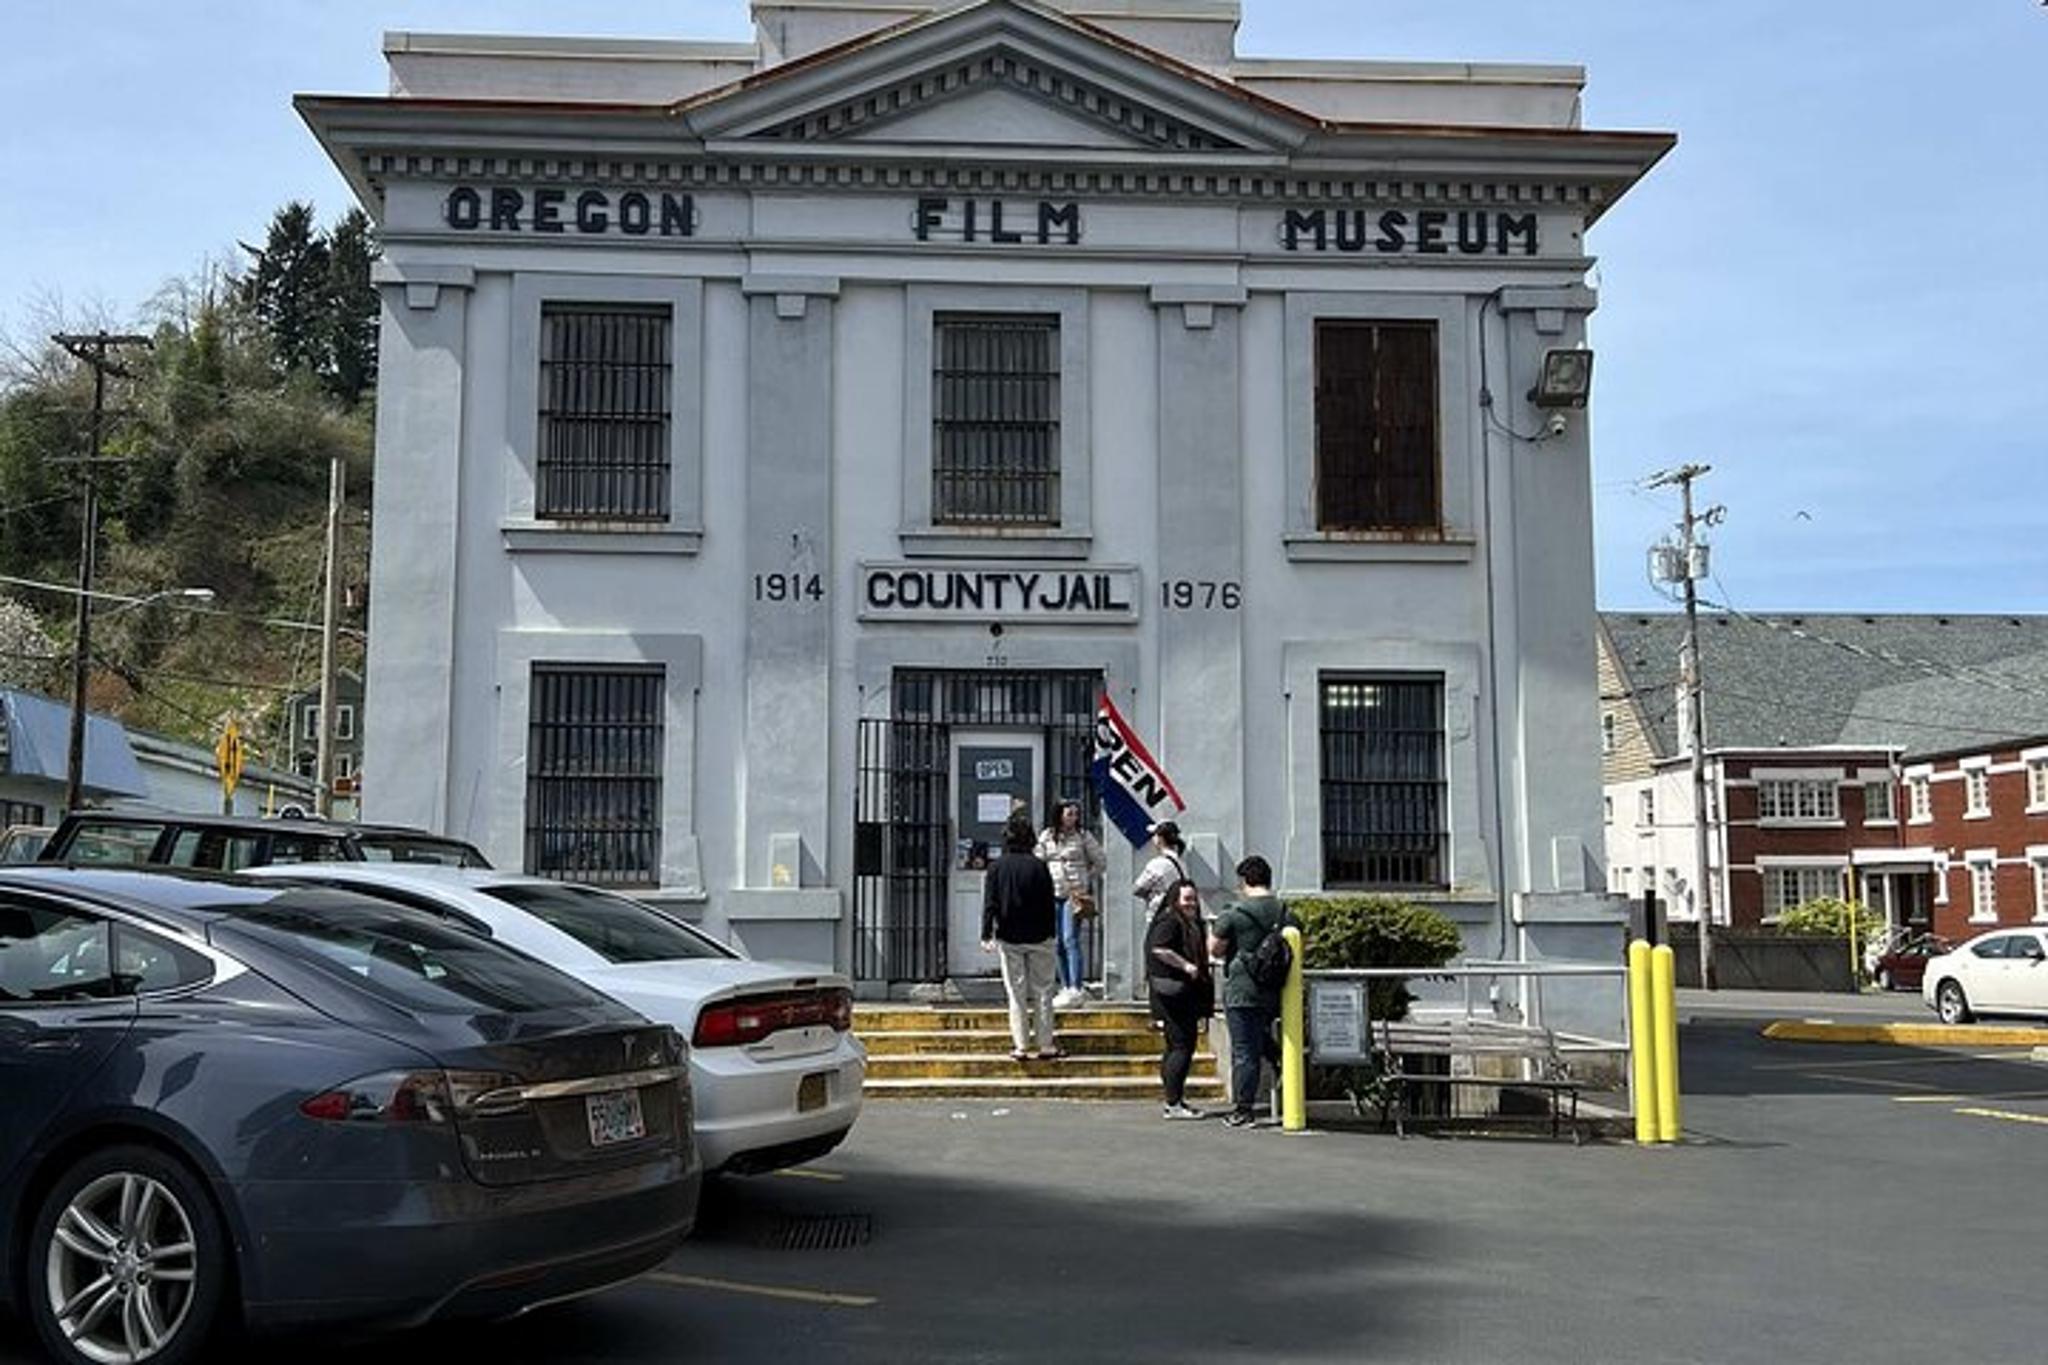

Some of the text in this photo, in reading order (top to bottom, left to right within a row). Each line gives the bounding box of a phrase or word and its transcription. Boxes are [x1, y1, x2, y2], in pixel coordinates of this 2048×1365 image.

[448, 187, 1537, 255] OREGON FILM MUSEUM
[755, 573, 825, 601] 1914
[1161, 581, 1241, 609] 1976
